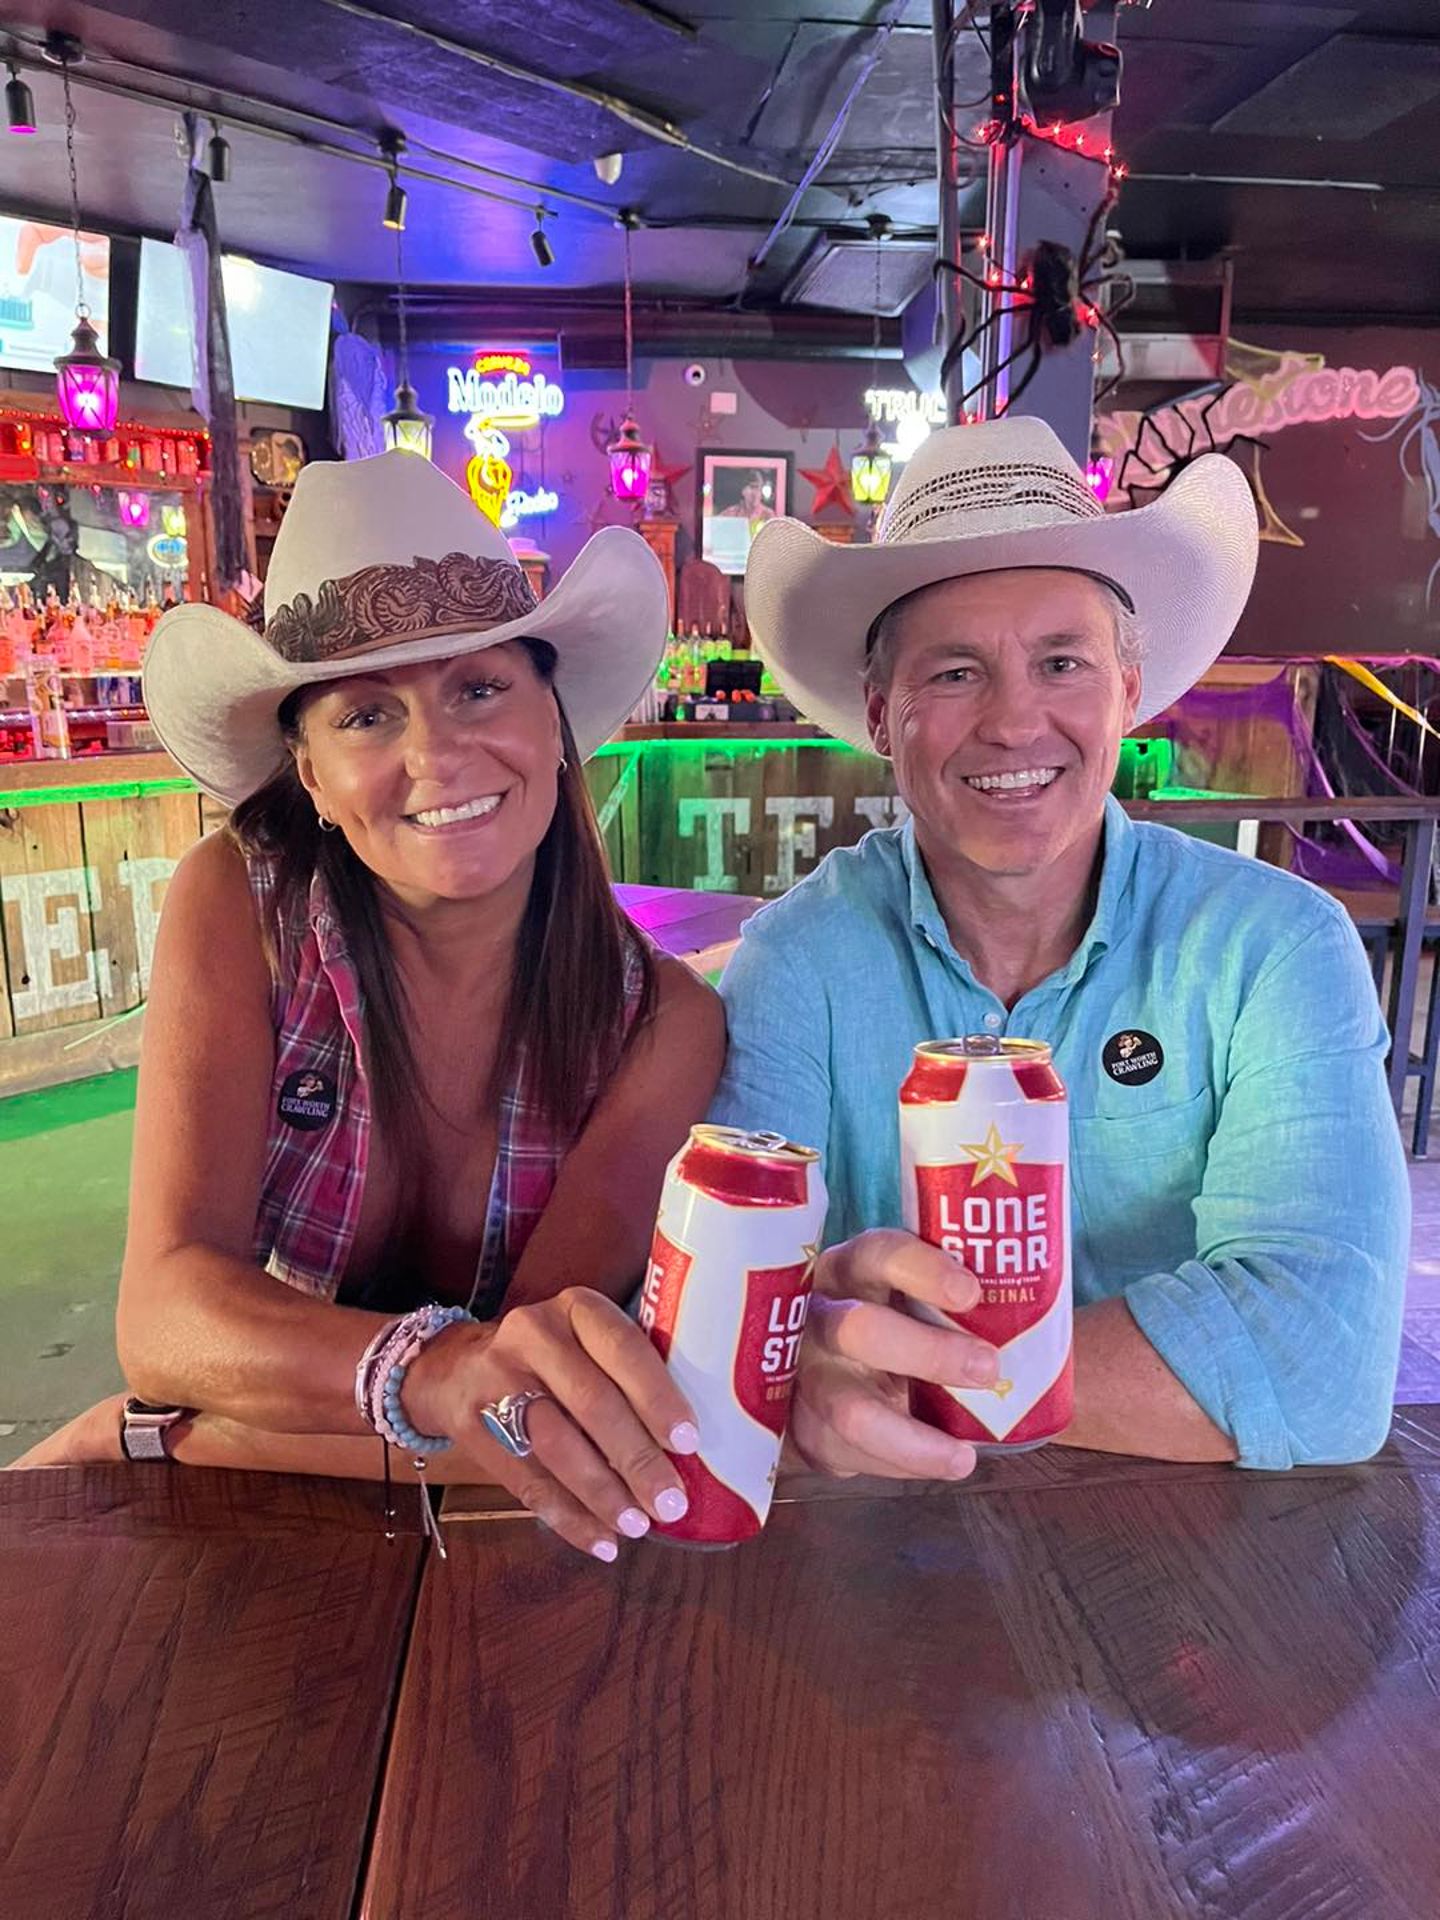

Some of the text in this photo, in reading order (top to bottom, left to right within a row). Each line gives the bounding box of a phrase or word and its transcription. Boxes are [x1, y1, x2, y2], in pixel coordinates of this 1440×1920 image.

[447, 367, 564, 415] Modelo
[1113, 1057, 1158, 1076] CRAWLING
[940, 1193, 1047, 1234] LONE
[941, 1235, 1049, 1274] STAR
[768, 1293, 811, 1333] LO
[761, 1334, 802, 1373] ST
